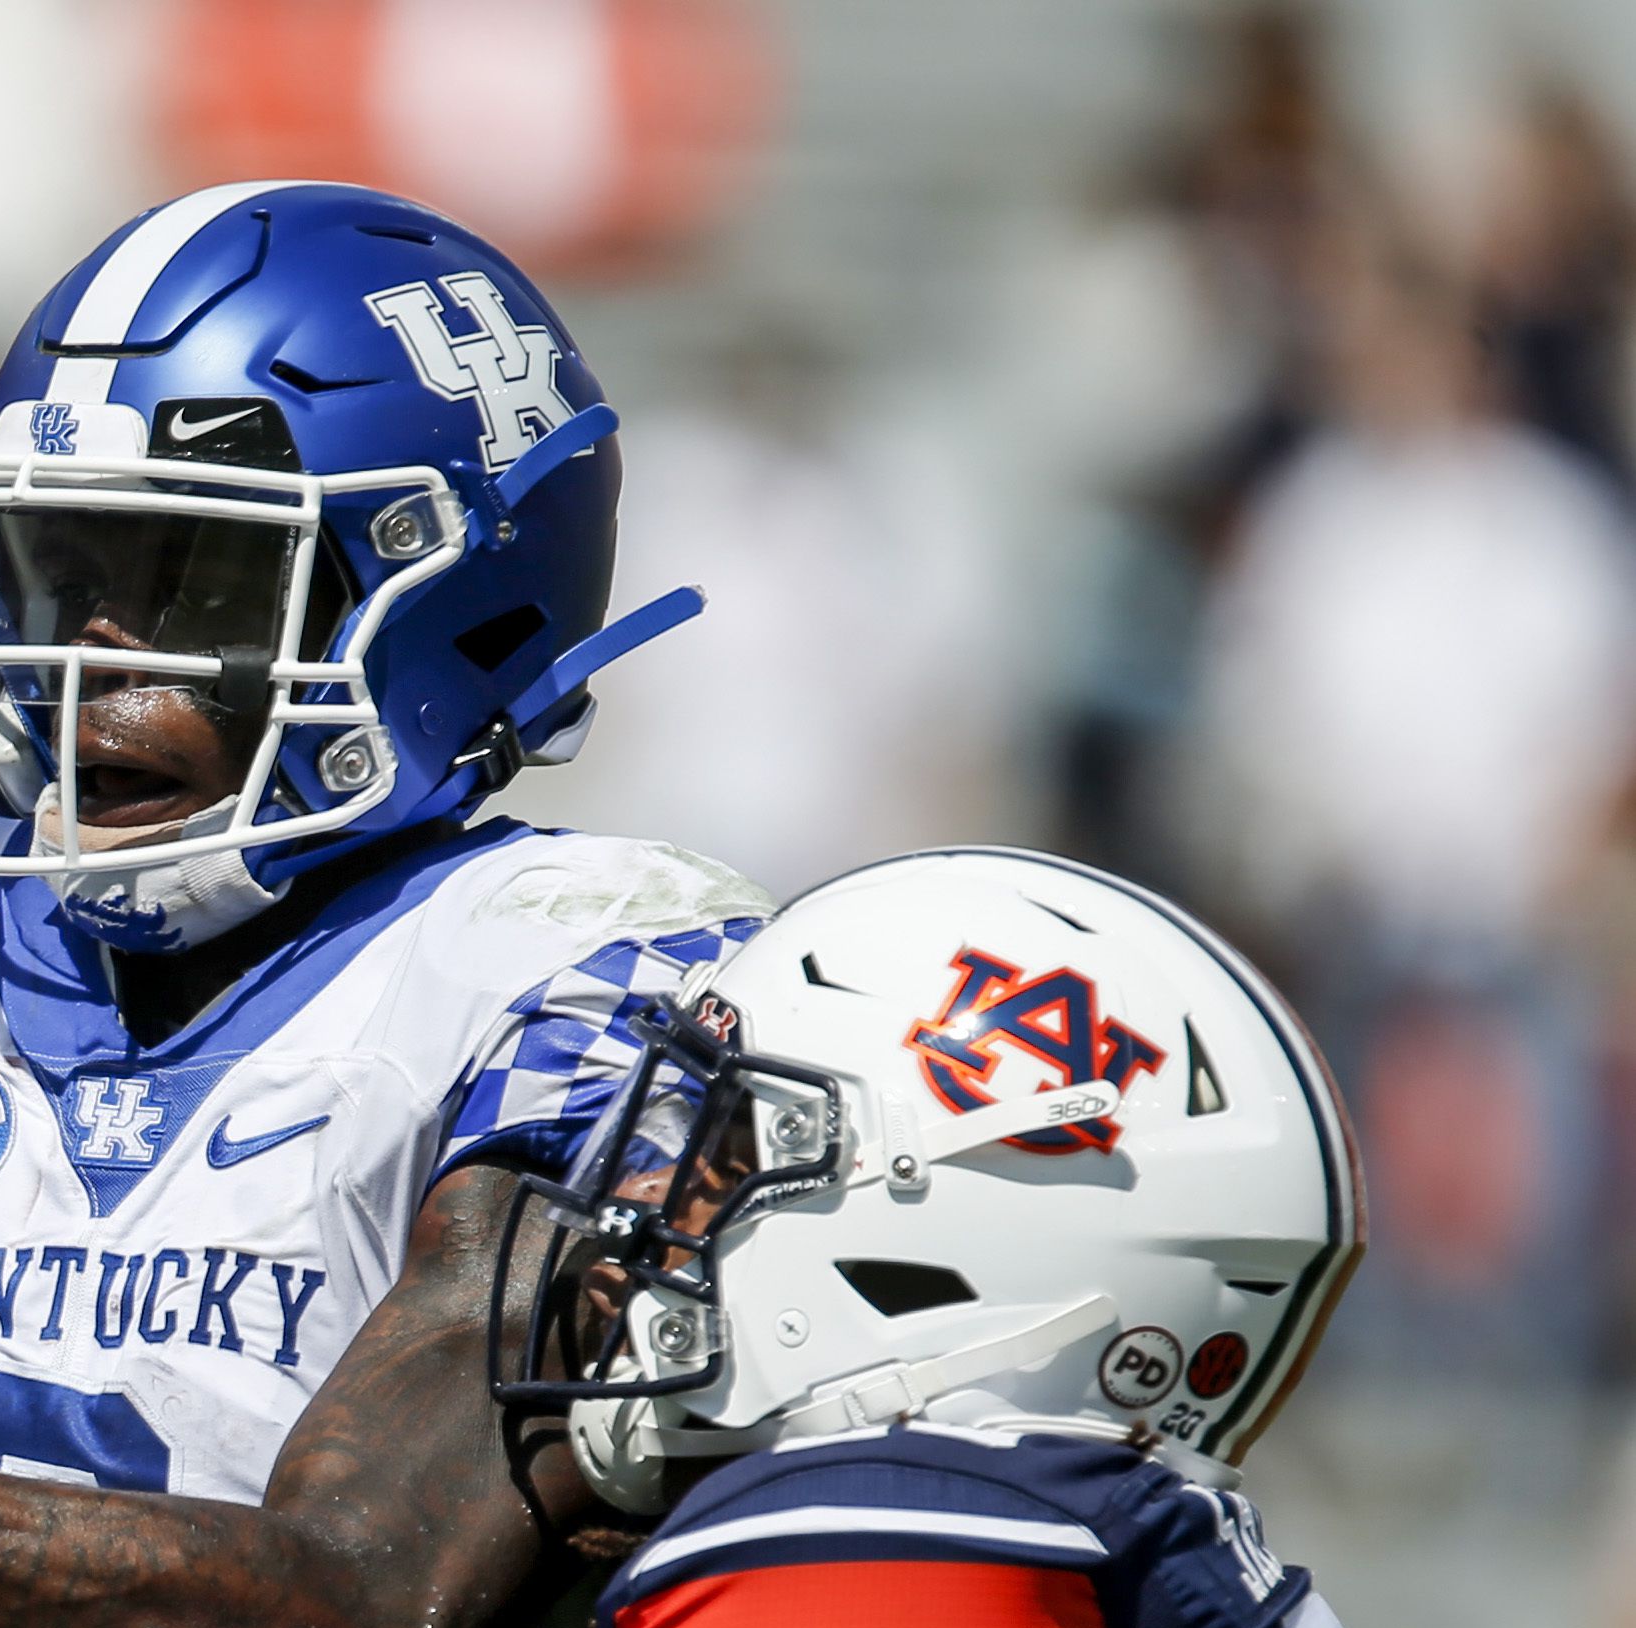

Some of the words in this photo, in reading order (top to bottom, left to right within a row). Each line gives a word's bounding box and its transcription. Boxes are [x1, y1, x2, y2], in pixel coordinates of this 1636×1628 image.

[362, 270, 595, 474] UK
[29, 403, 81, 456] UK
[74, 1073, 167, 1162] UK
[1113, 1346, 1169, 1388] PD
[1158, 1402, 1206, 1441] 20
